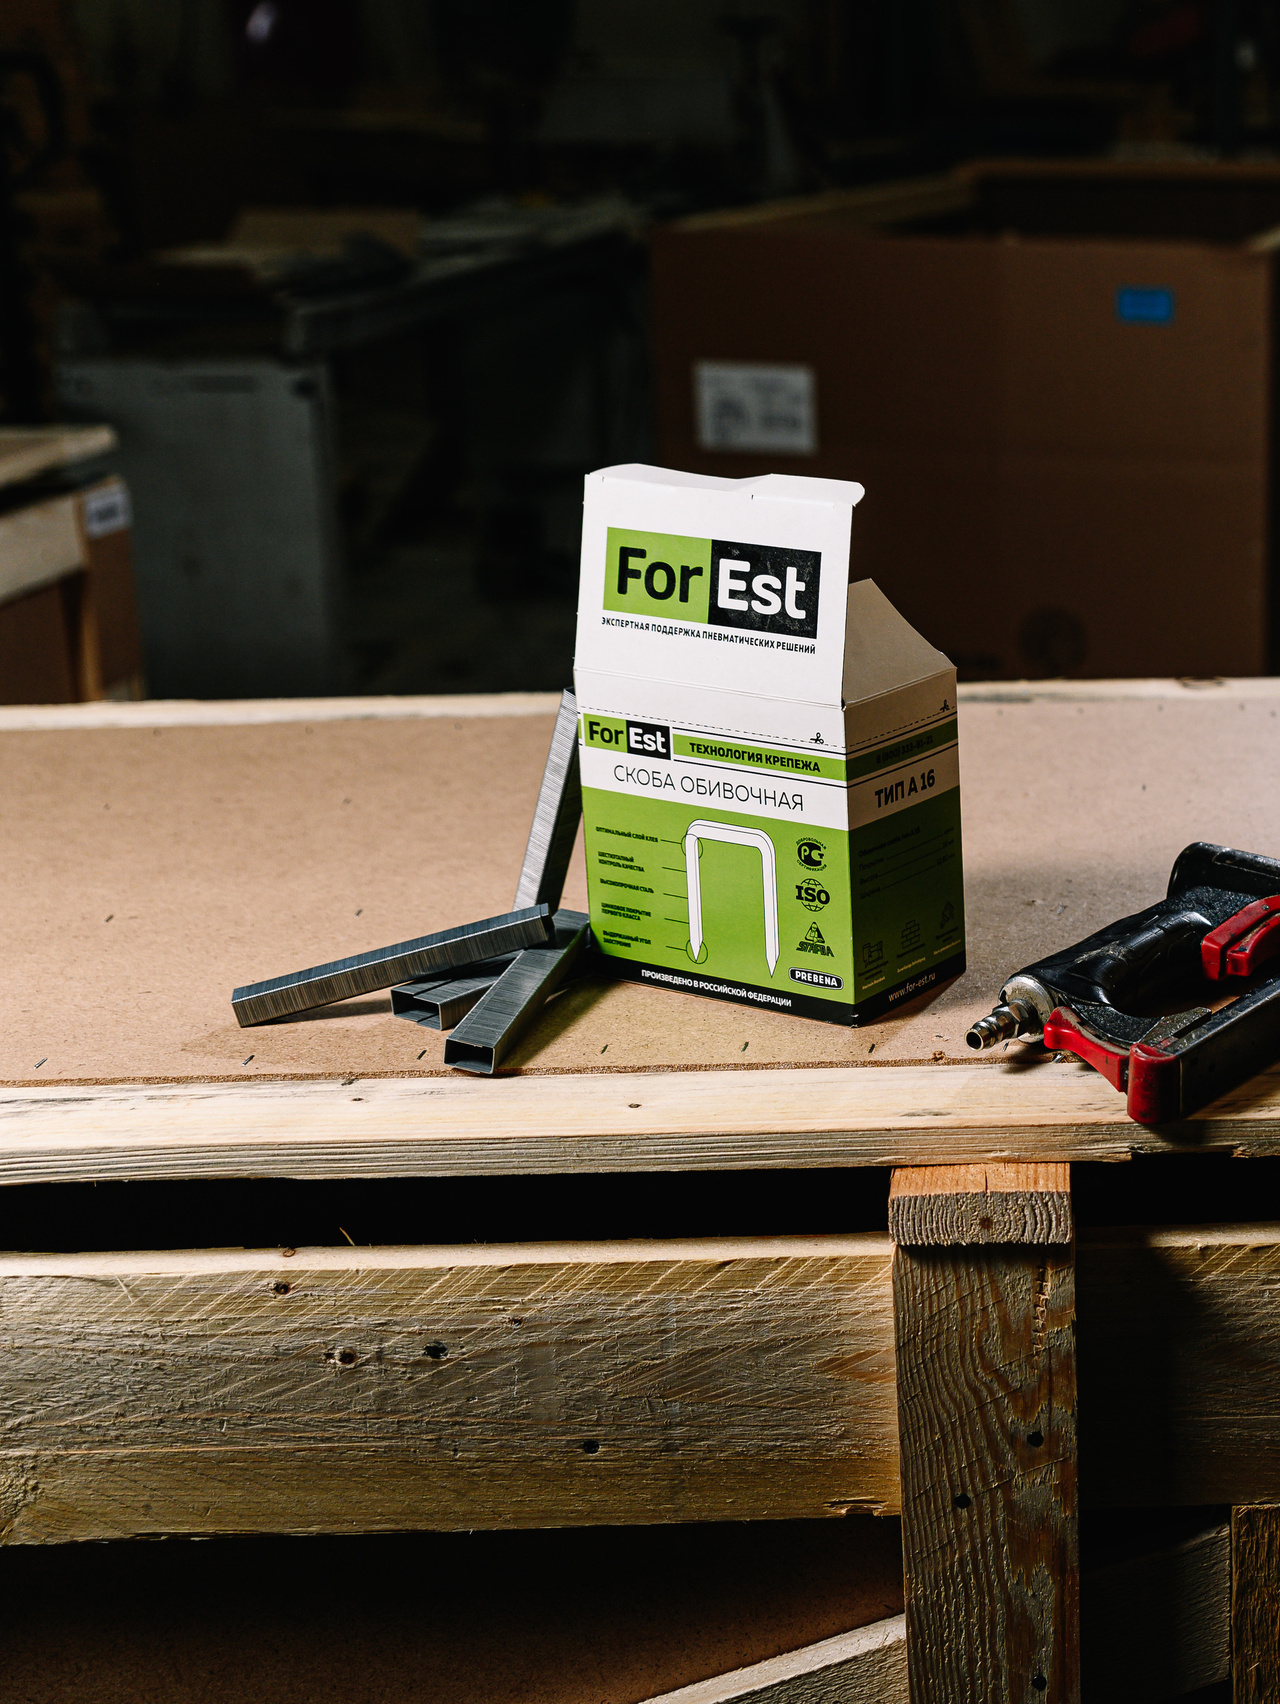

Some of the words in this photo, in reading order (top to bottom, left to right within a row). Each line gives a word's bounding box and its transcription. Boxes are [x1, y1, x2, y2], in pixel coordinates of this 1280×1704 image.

[617, 545, 704, 604] For
[717, 558, 806, 620] Est
[601, 616, 650, 631] ЭКСПЕРТНАЯ
[651, 623, 701, 639] ПОДДЕРЖКА
[702, 630, 775, 649] ПНЕВМАТИЧЕСКИХ
[776, 640, 816, 655] РЕШЕНИЙ
[588, 720, 624, 746] For
[629, 727, 667, 753] Est
[689, 742, 763, 764] ТЕХНОЛОГИЯ
[764, 753, 821, 773] КРЕПЕЖА
[613, 764, 676, 791] СКОБА
[680, 774, 804, 812] ОБИВОЧНАЯ
[875, 780, 905, 810] ТИП
[920, 769, 935, 791] 16
[595, 826, 632, 838] ОПТИМАЛЬНЫЙ
[632, 833, 645, 842] СЛОЙ
[645, 835, 658, 843] КЛЕЯ
[622, 863, 645, 873] КАЧЕСТВА
[639, 886, 655, 894] СТАЛЬ
[795, 885, 831, 905] ISO
[641, 969, 693, 987] ПРОИЗВЕДЕНО
[693, 978, 699, 988] В
[699, 979, 747, 998] РОССИЙСКОЙ
[747, 988, 792, 1008] ФЕДЕРАЦИИ
[795, 970, 838, 987] PREBENA
[887, 971, 936, 1003] www.for-est.ru
